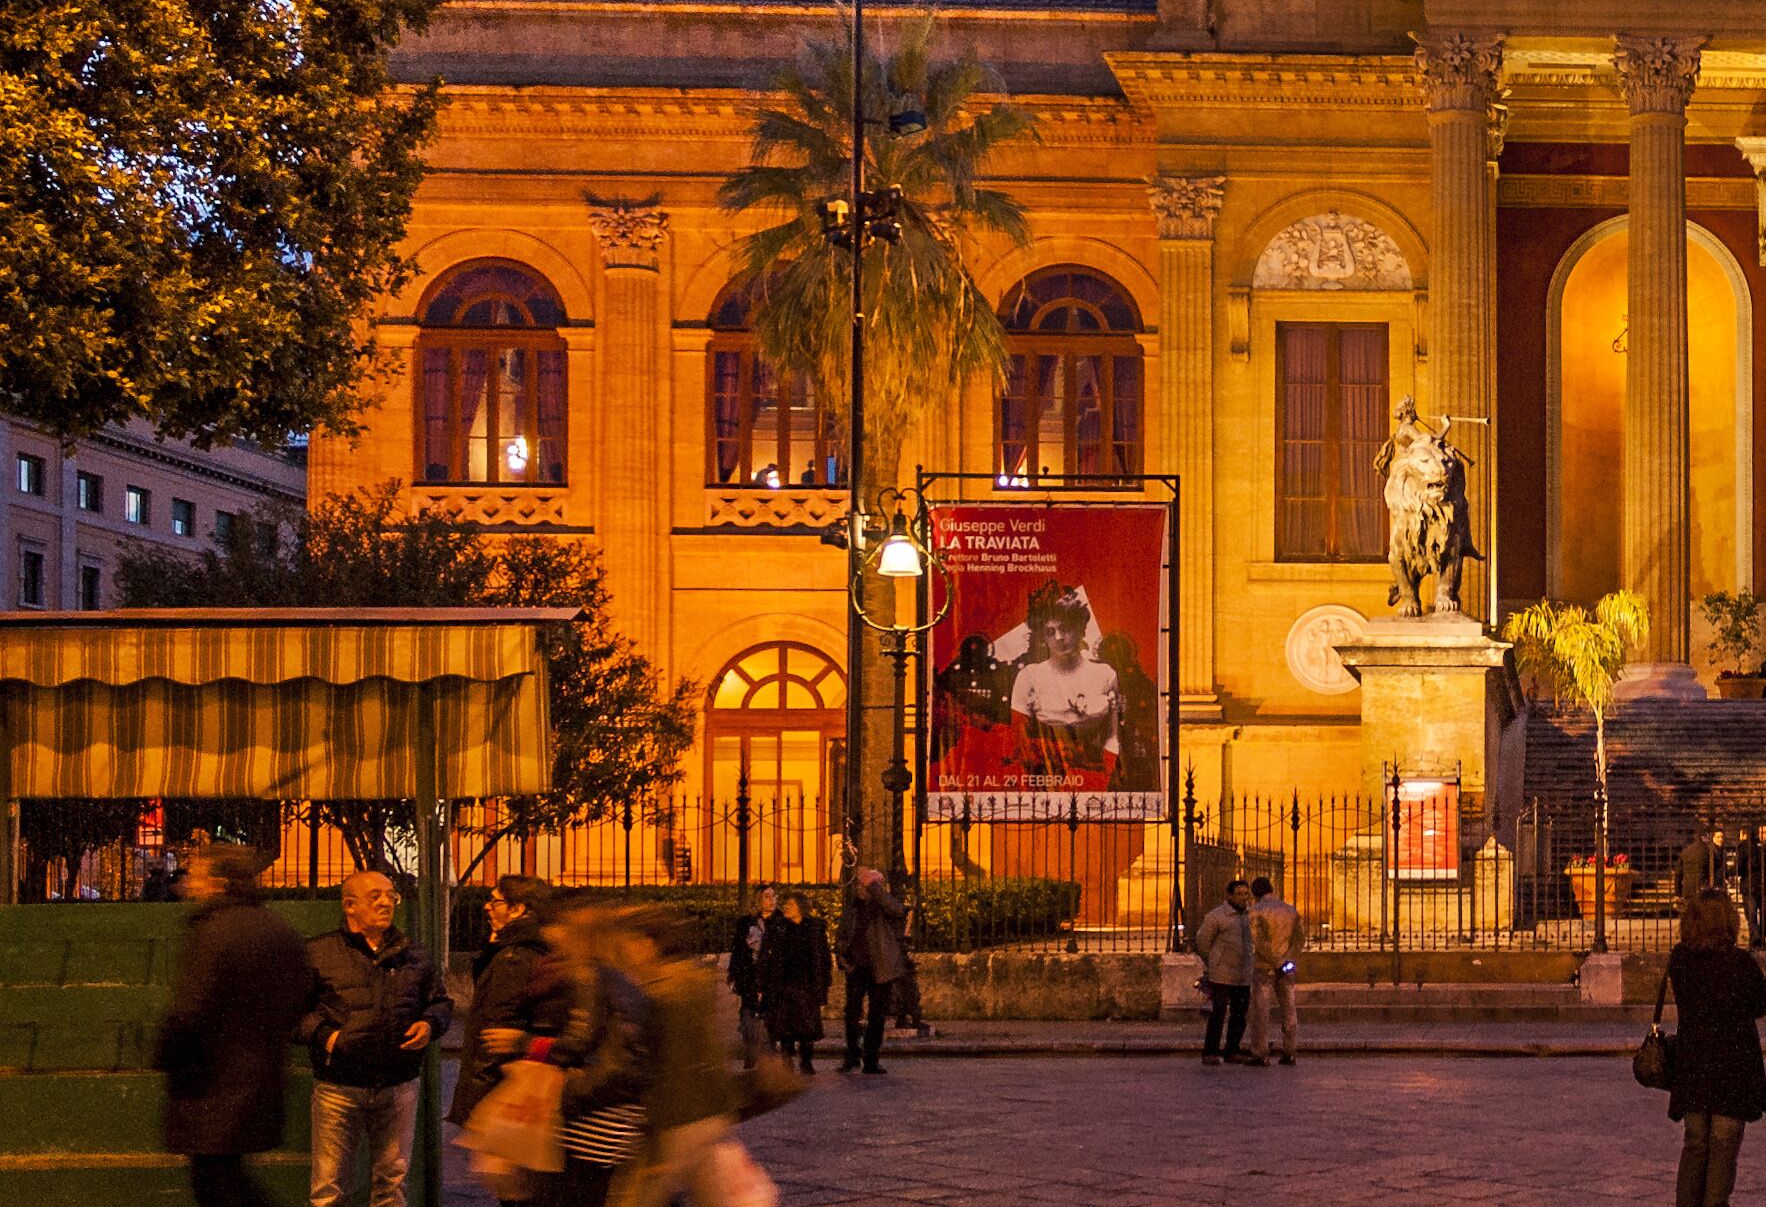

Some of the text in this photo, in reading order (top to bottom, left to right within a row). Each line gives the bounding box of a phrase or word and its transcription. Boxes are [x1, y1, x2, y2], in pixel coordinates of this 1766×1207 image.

[939, 518, 1046, 535] Giuseppe Verdi
[940, 536, 1040, 549] LA TRAVIATA
[981, 553, 1009, 562] Bruno
[1011, 553, 1057, 562] Bartoletti
[967, 563, 1005, 573] Henning
[1007, 563, 1057, 572] Brockhaus
[939, 775, 1084, 787] DAL 21 AL 29 FEBBRAIO
